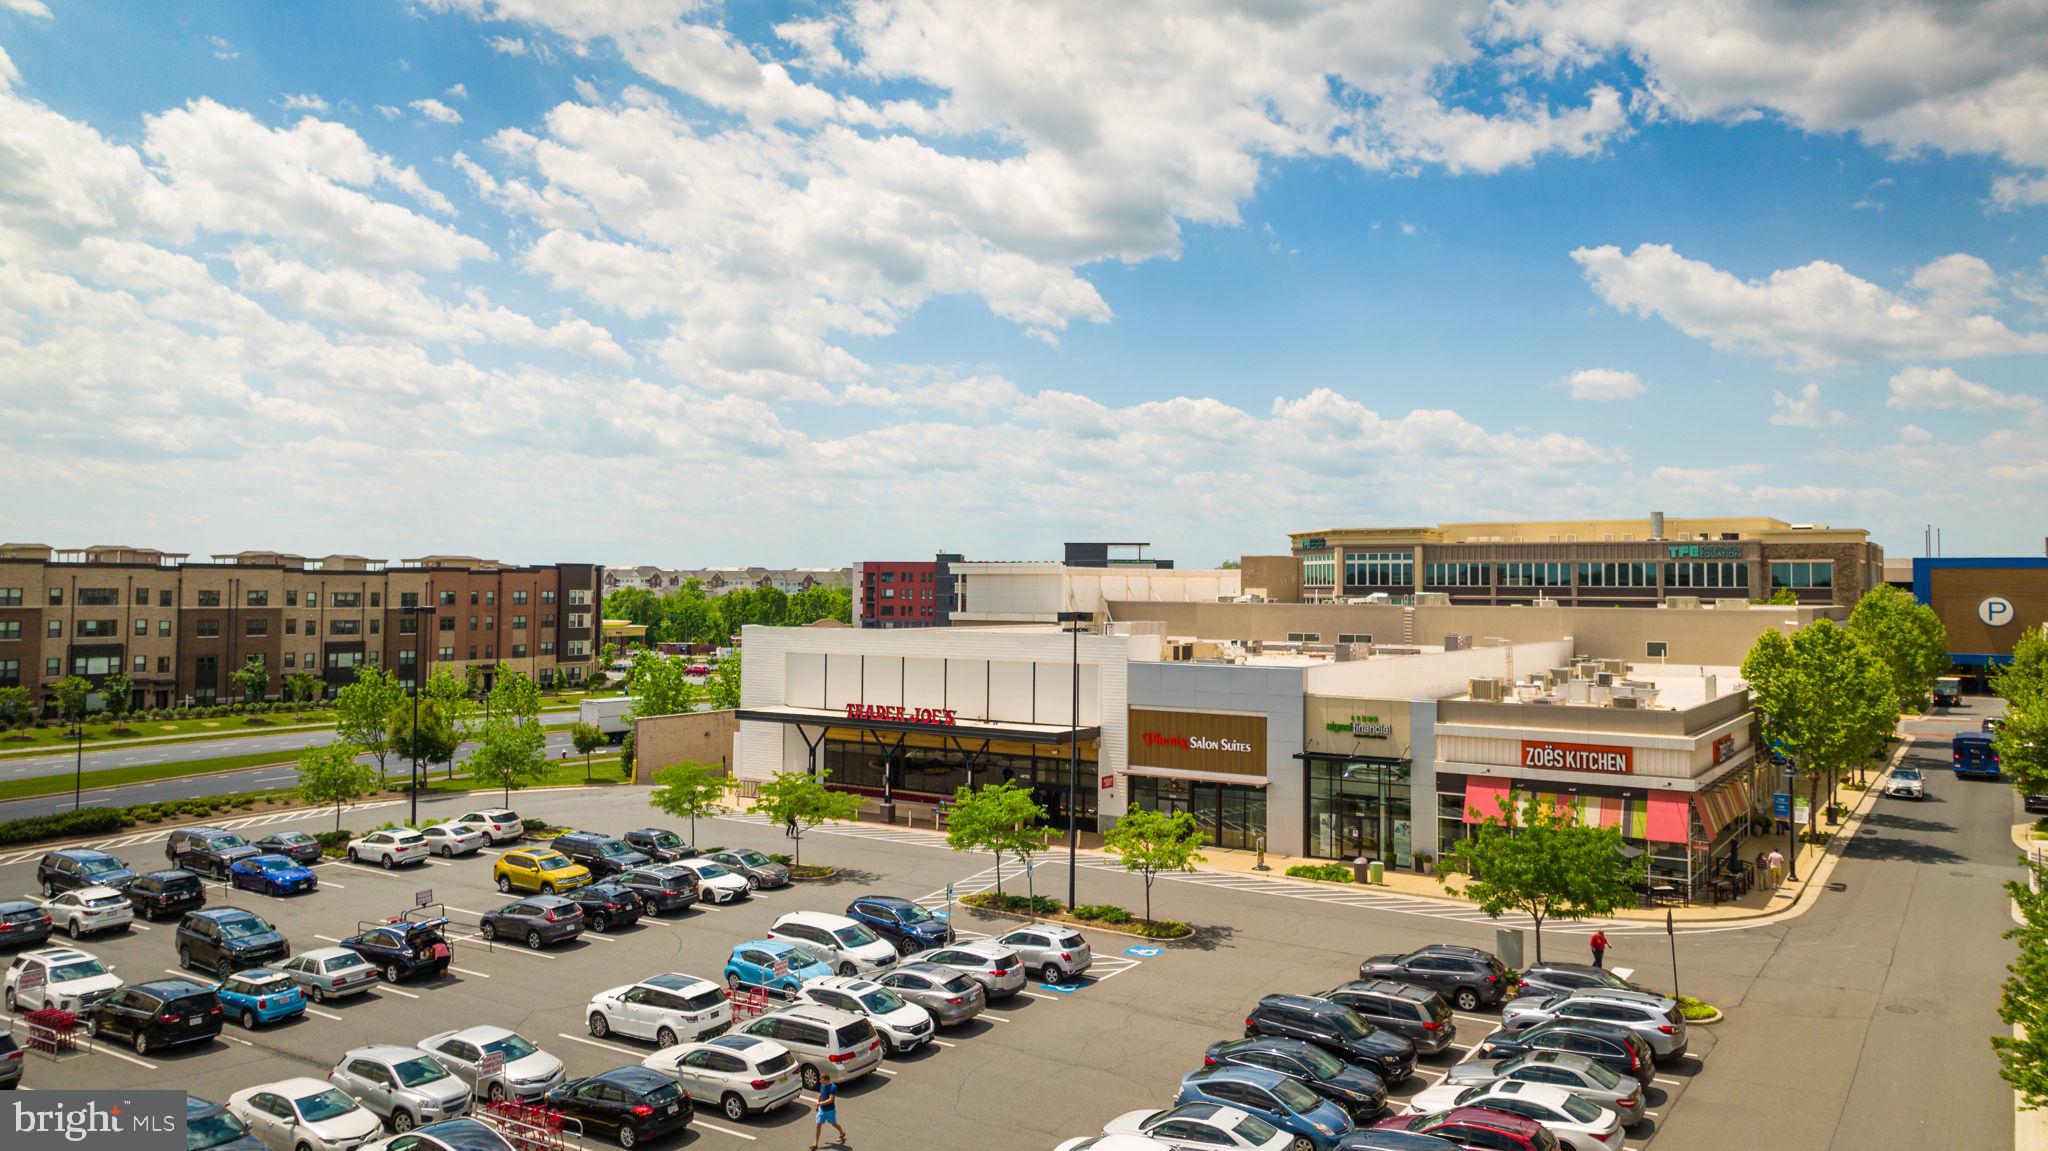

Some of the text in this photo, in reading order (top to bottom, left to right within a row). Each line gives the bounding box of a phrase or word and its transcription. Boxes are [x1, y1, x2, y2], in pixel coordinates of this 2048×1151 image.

[1988, 601, 2007, 621] P
[846, 703, 957, 726] TRADER JOE'S
[1566, 750, 1627, 772] KITCHEN
